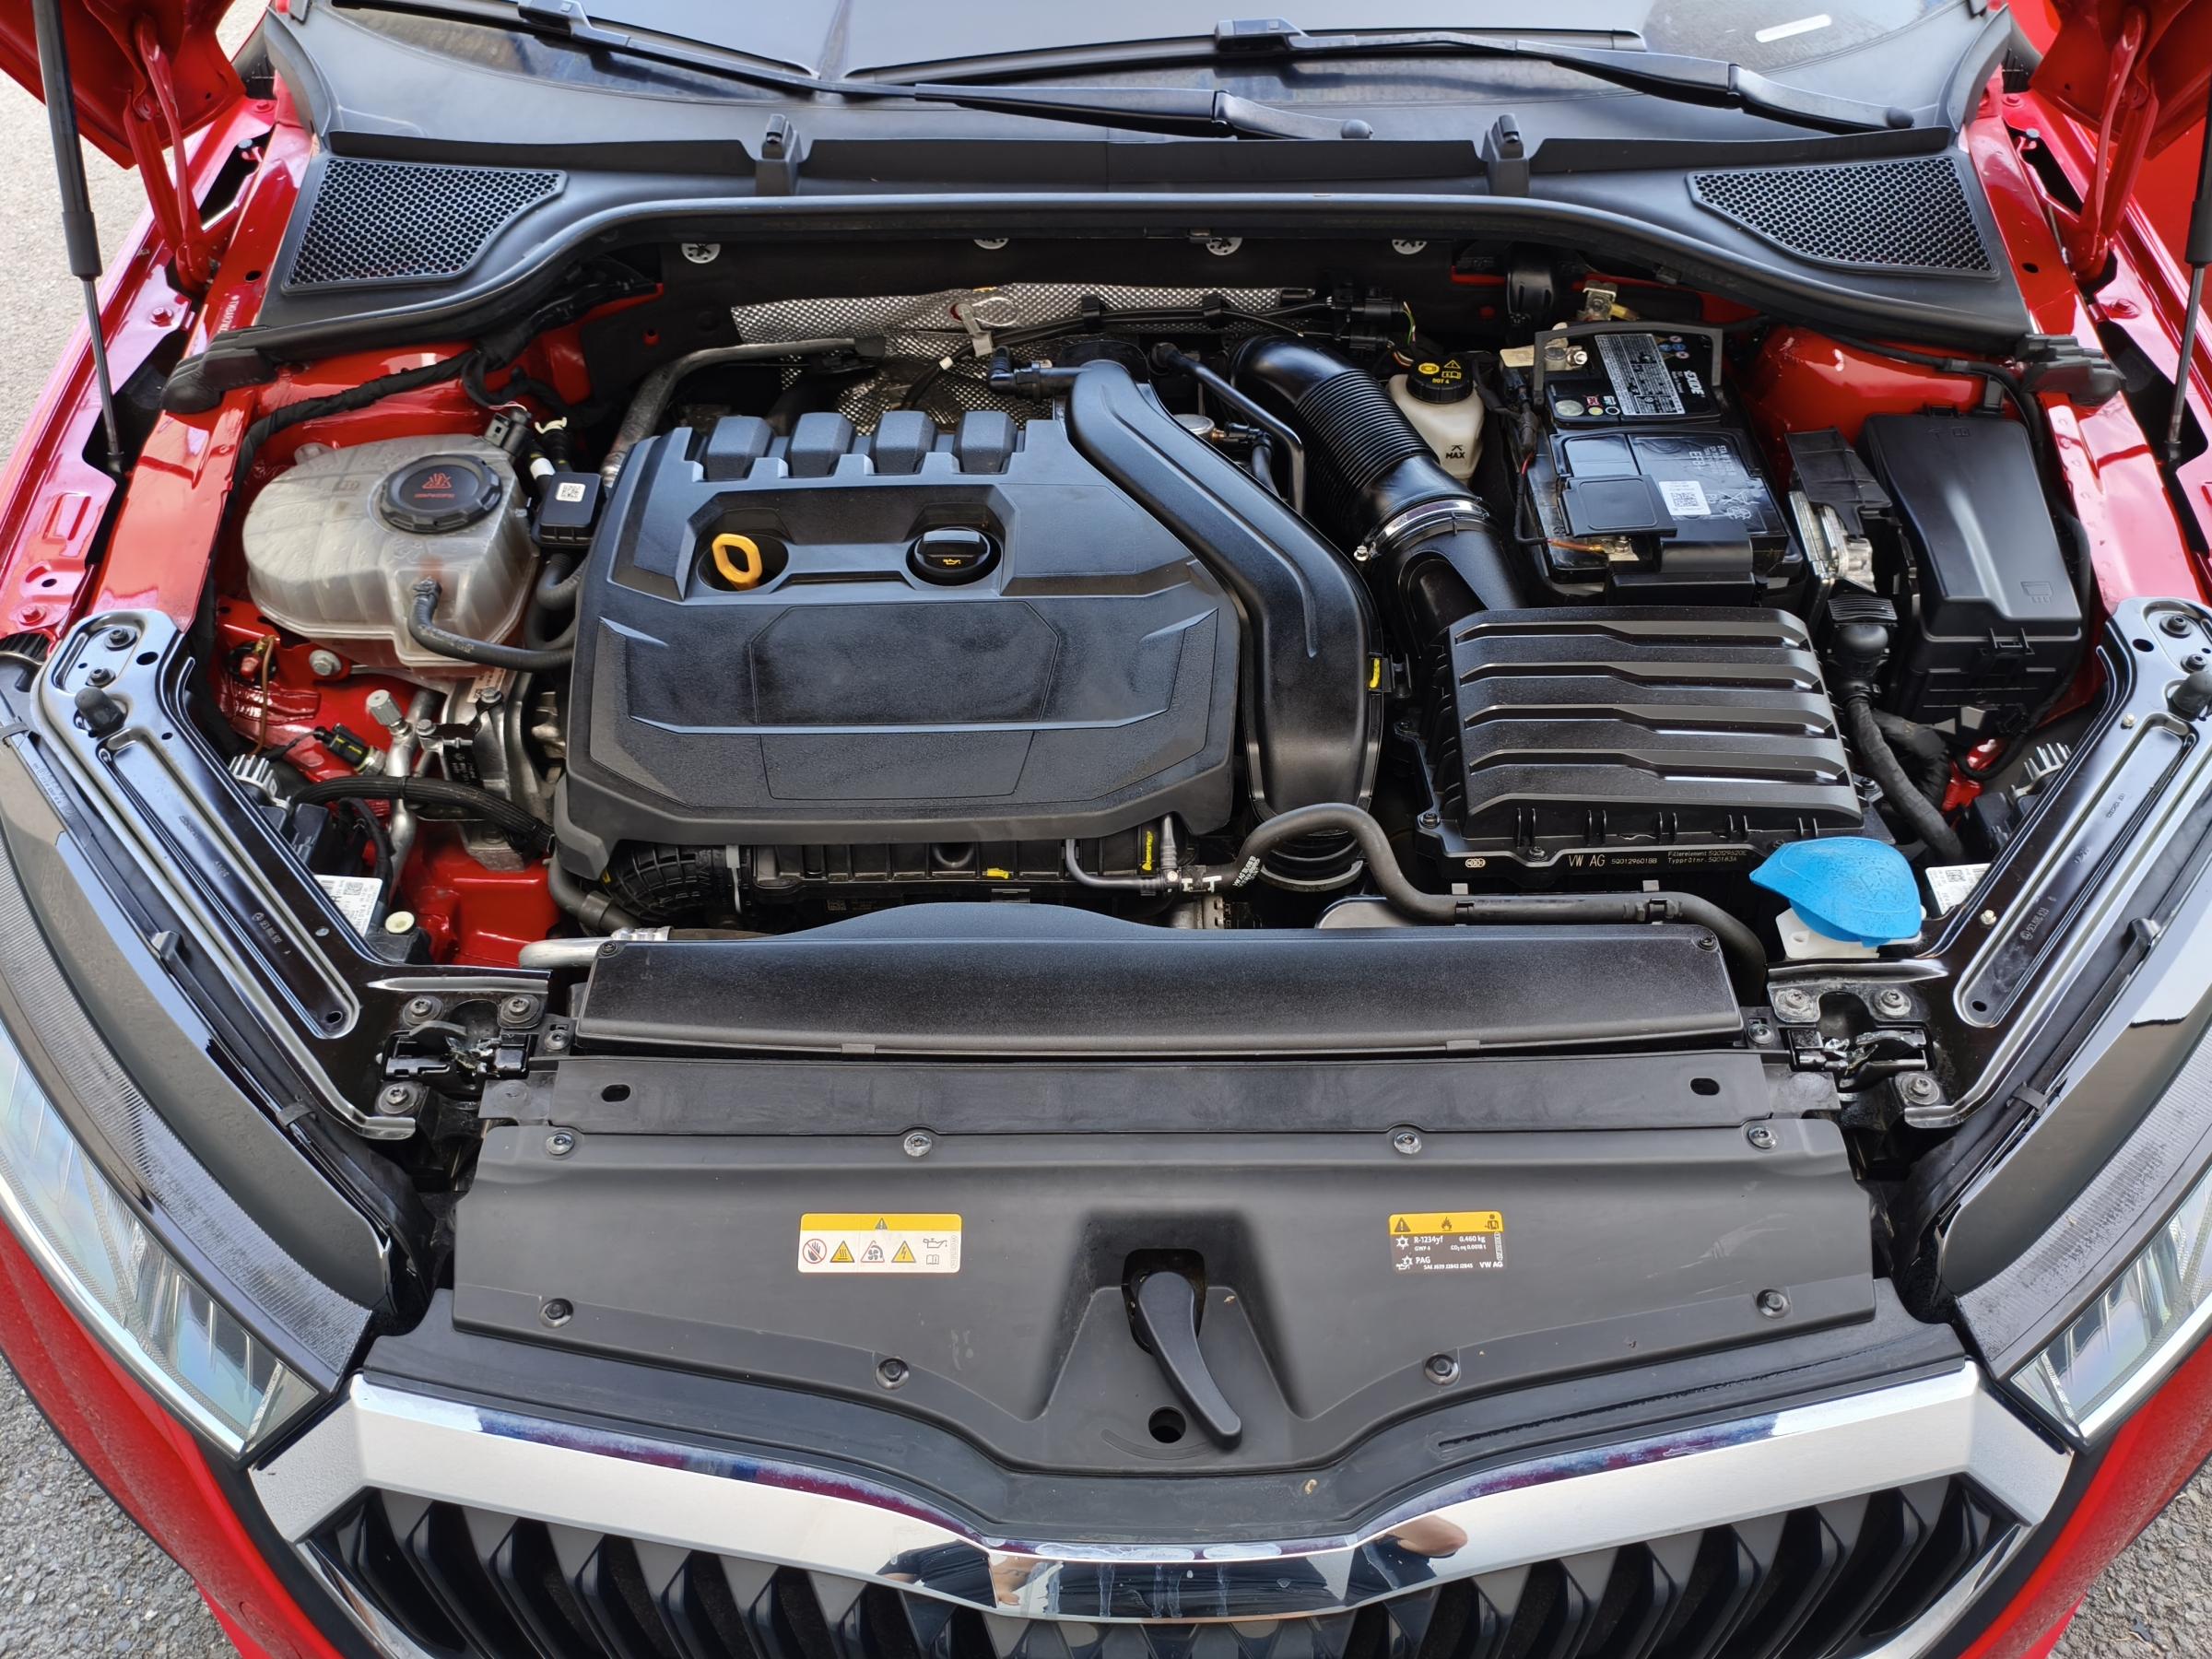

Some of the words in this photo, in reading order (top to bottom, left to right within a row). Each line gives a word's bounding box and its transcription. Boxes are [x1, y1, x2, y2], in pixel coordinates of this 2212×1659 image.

[1683, 370, 1705, 394] EXIDE
[1568, 854, 1584, 867] VW
[1588, 853, 1606, 867] AG
[1414, 1236, 1443, 1244] R-1234yf
[1477, 1235, 1486, 1243] kg
